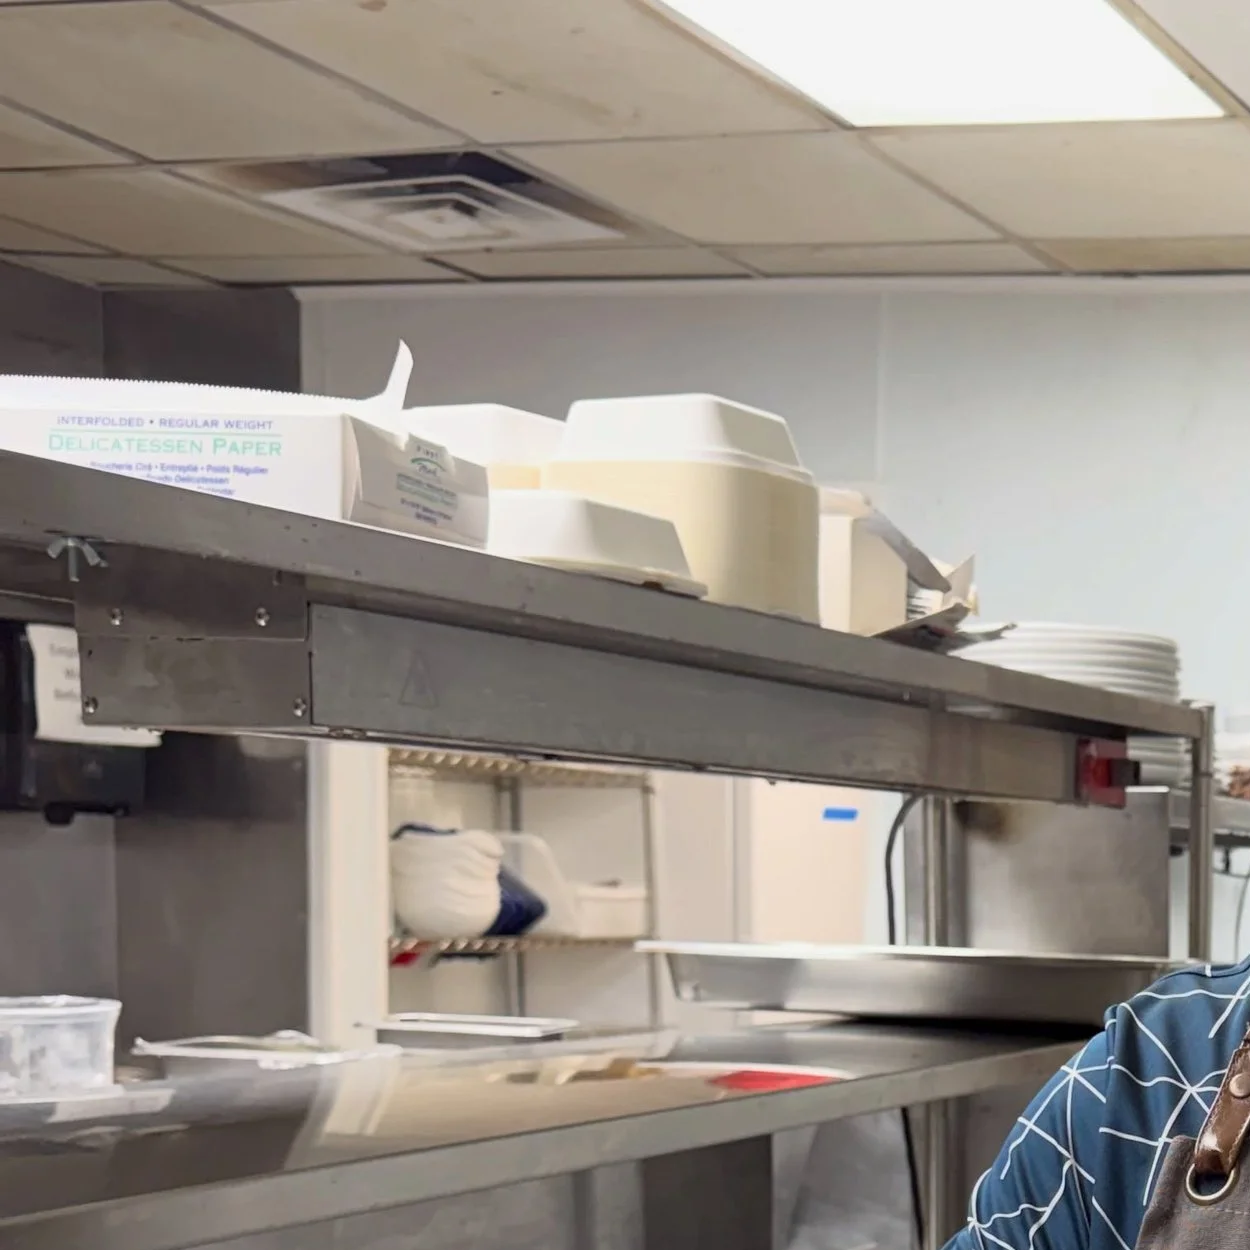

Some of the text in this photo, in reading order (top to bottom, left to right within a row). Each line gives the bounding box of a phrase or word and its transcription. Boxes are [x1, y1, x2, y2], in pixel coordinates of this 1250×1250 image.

[158, 417, 219, 429] REGULAR
[223, 419, 274, 430] WEIGHT
[48, 433, 283, 457] DELICATESSEN PAPER
